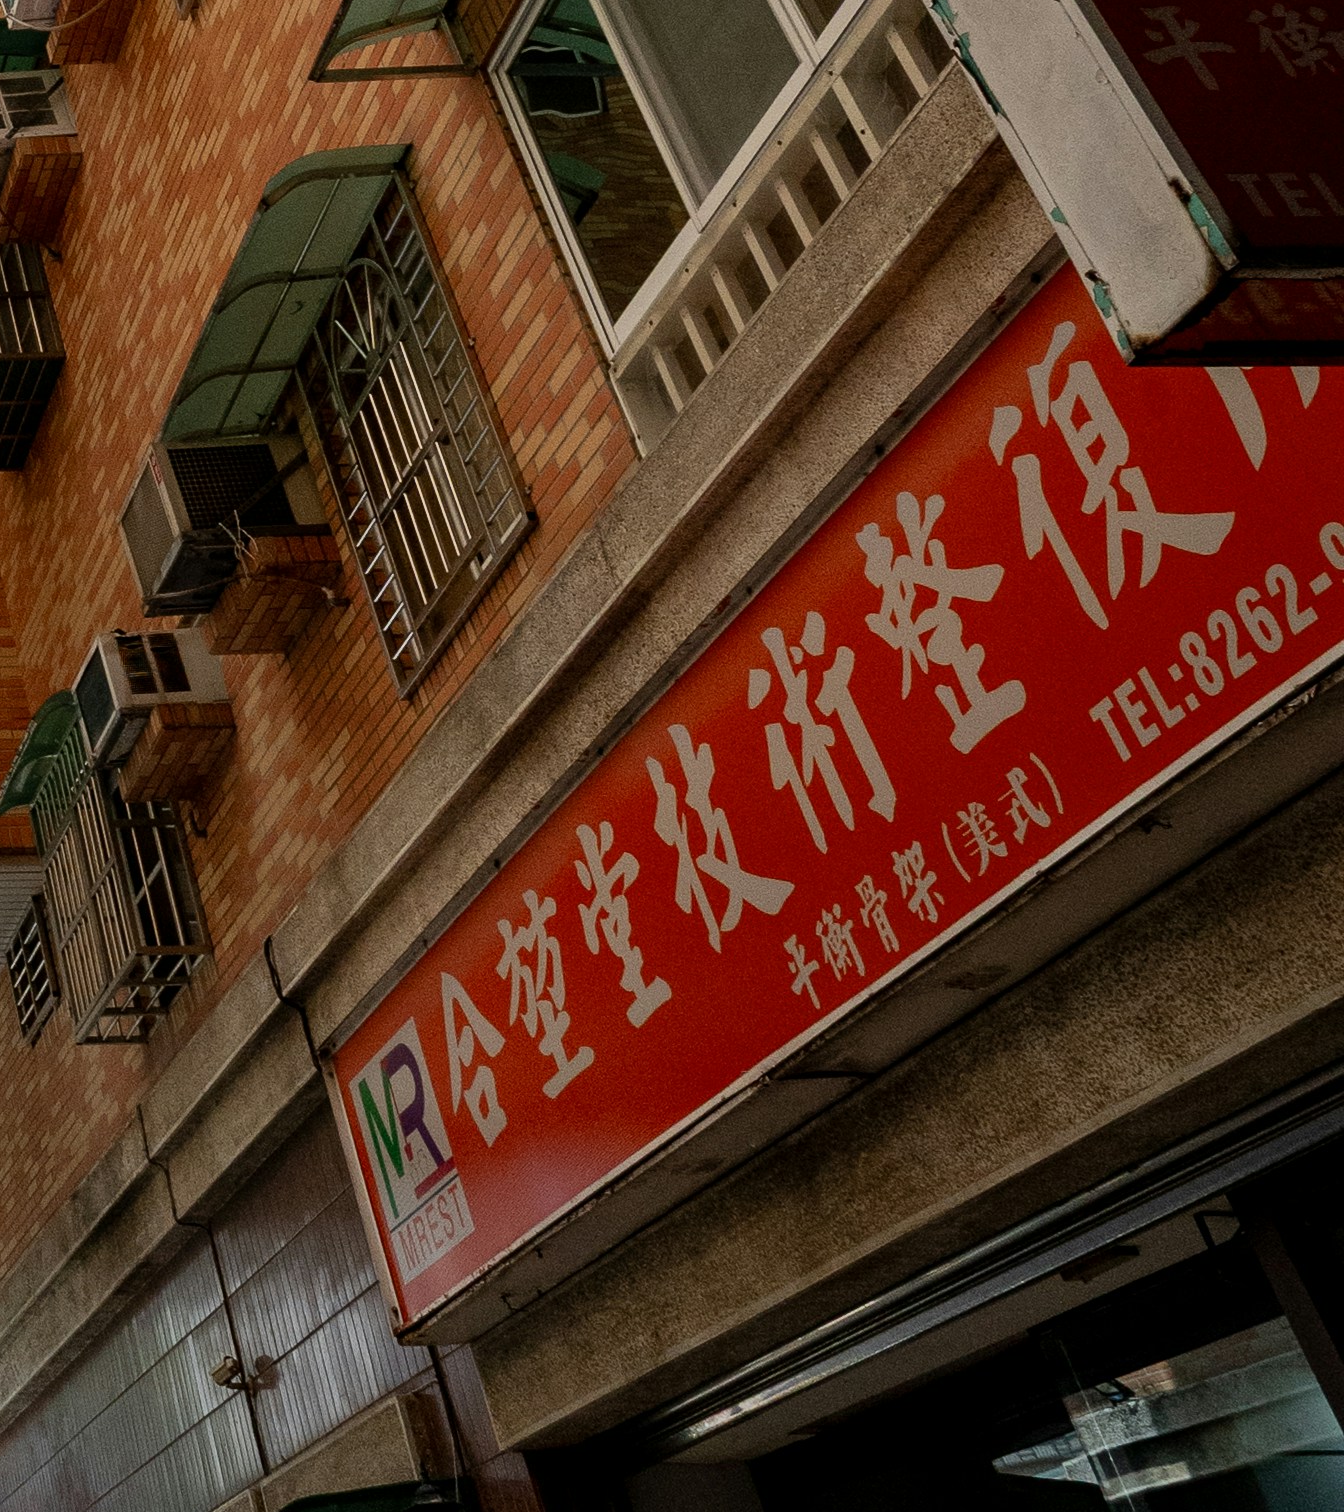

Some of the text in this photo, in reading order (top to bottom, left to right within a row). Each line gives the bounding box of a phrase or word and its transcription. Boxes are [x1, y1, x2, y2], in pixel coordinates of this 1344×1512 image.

[440, 319, 1320, 1148] 合堃堂技術整復
[398, 1181, 464, 1272] MREST
